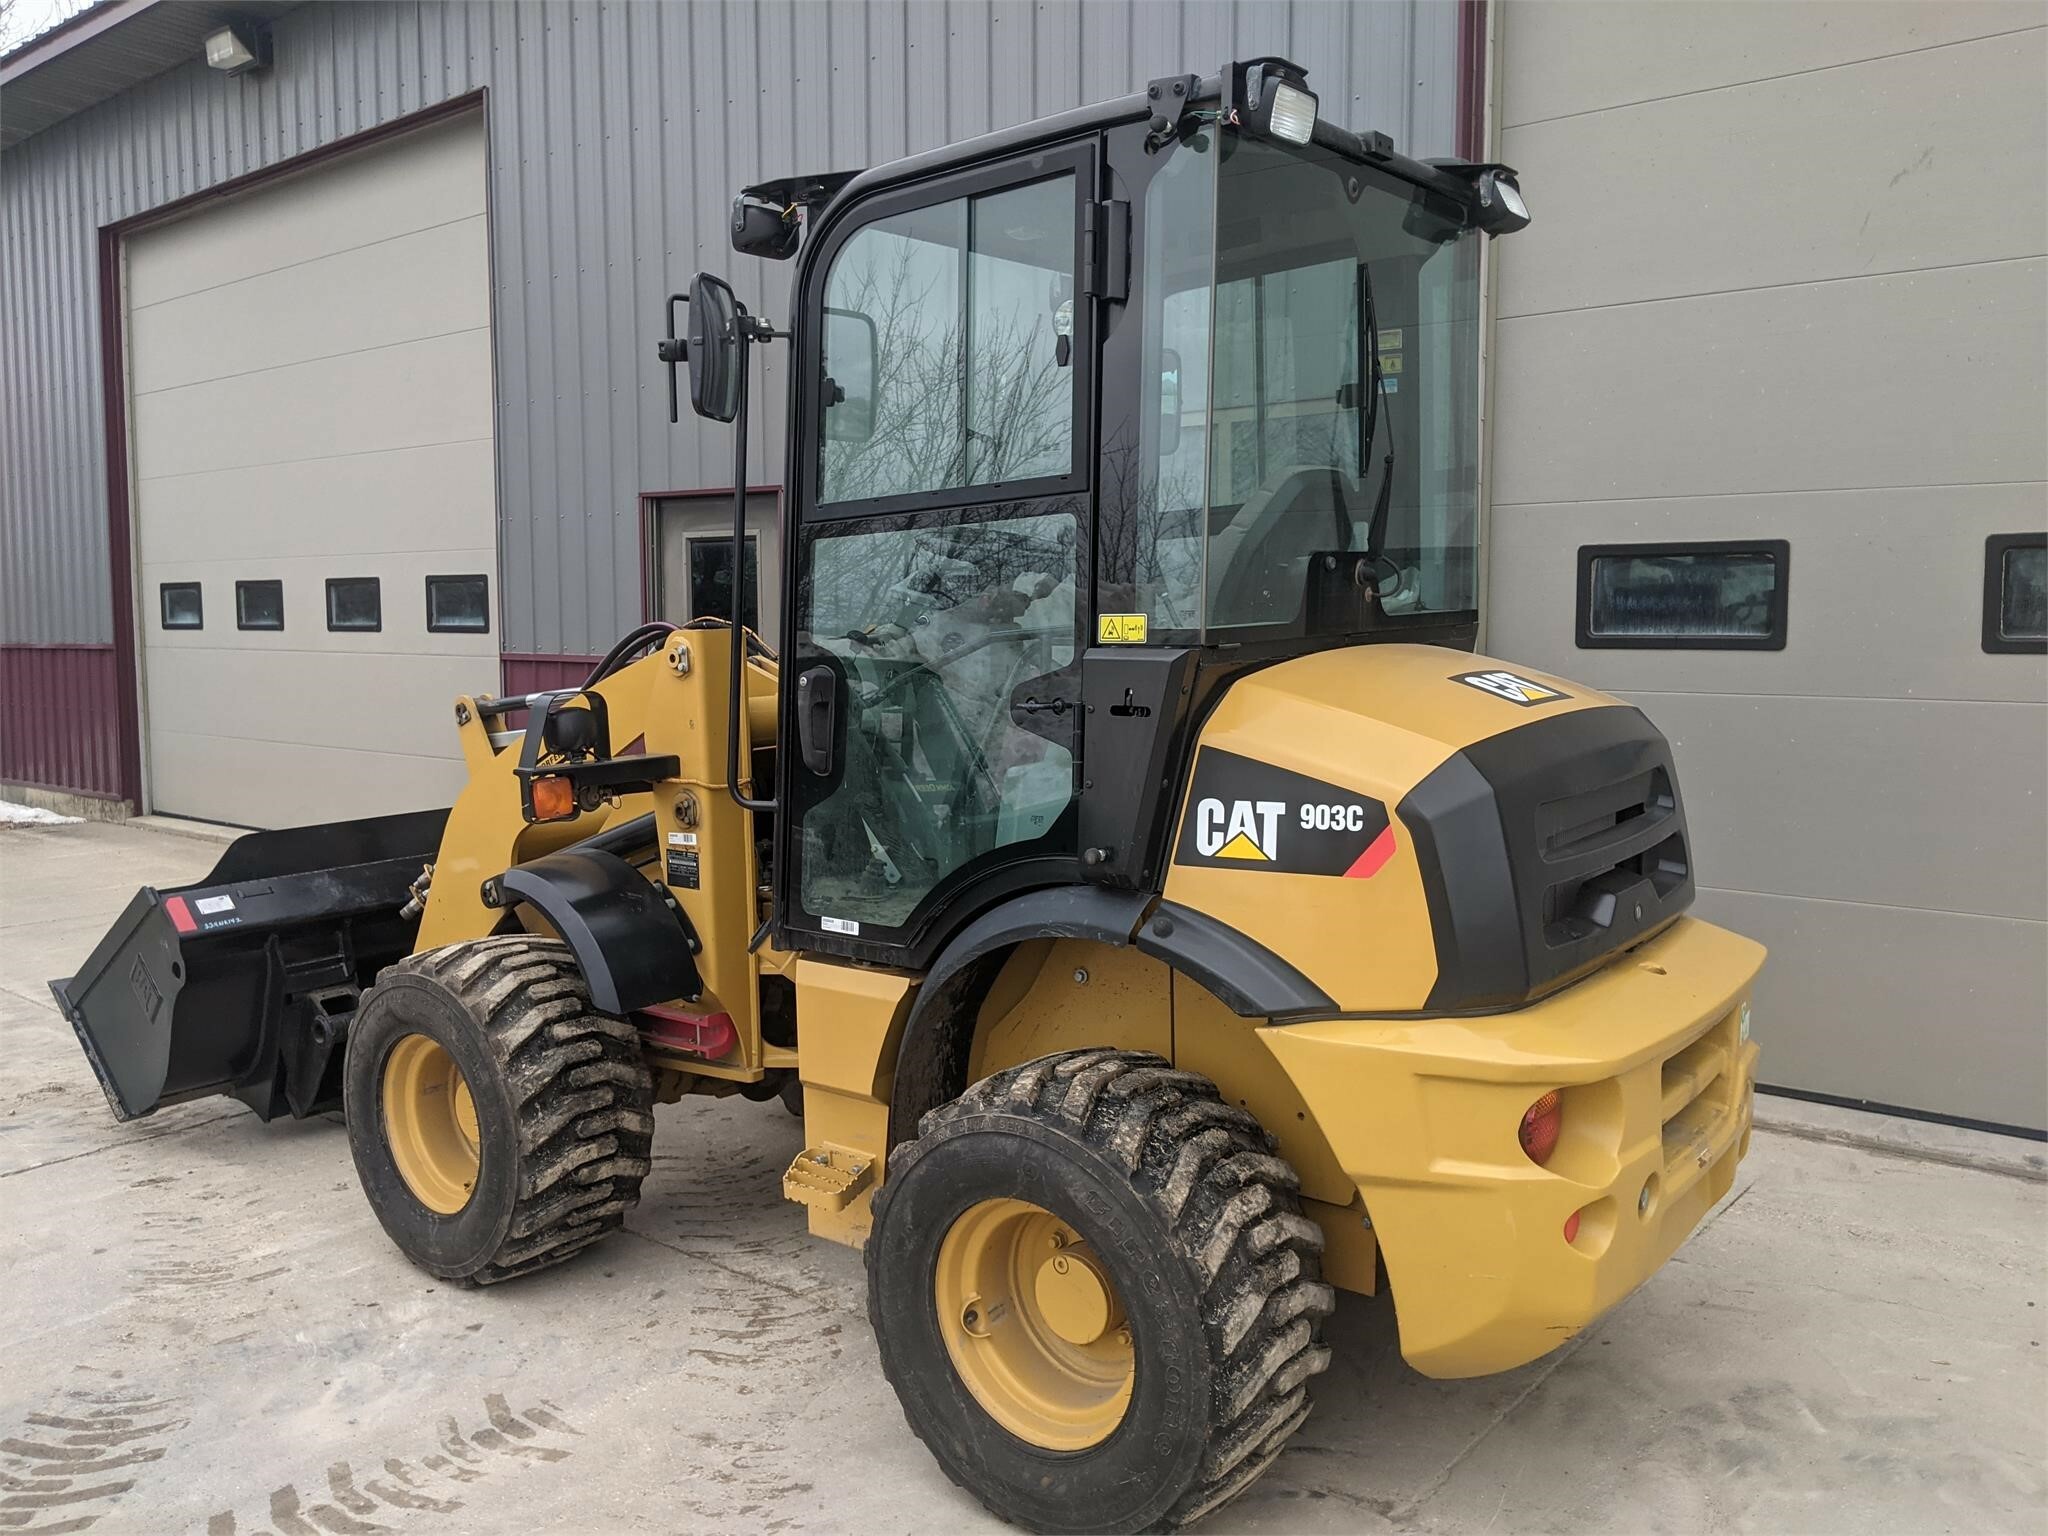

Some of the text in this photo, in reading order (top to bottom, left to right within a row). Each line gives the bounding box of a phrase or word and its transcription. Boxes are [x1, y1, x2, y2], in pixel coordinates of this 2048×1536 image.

[1464, 672, 1559, 702] CAT
[1196, 798, 1364, 861] CAT 903C
